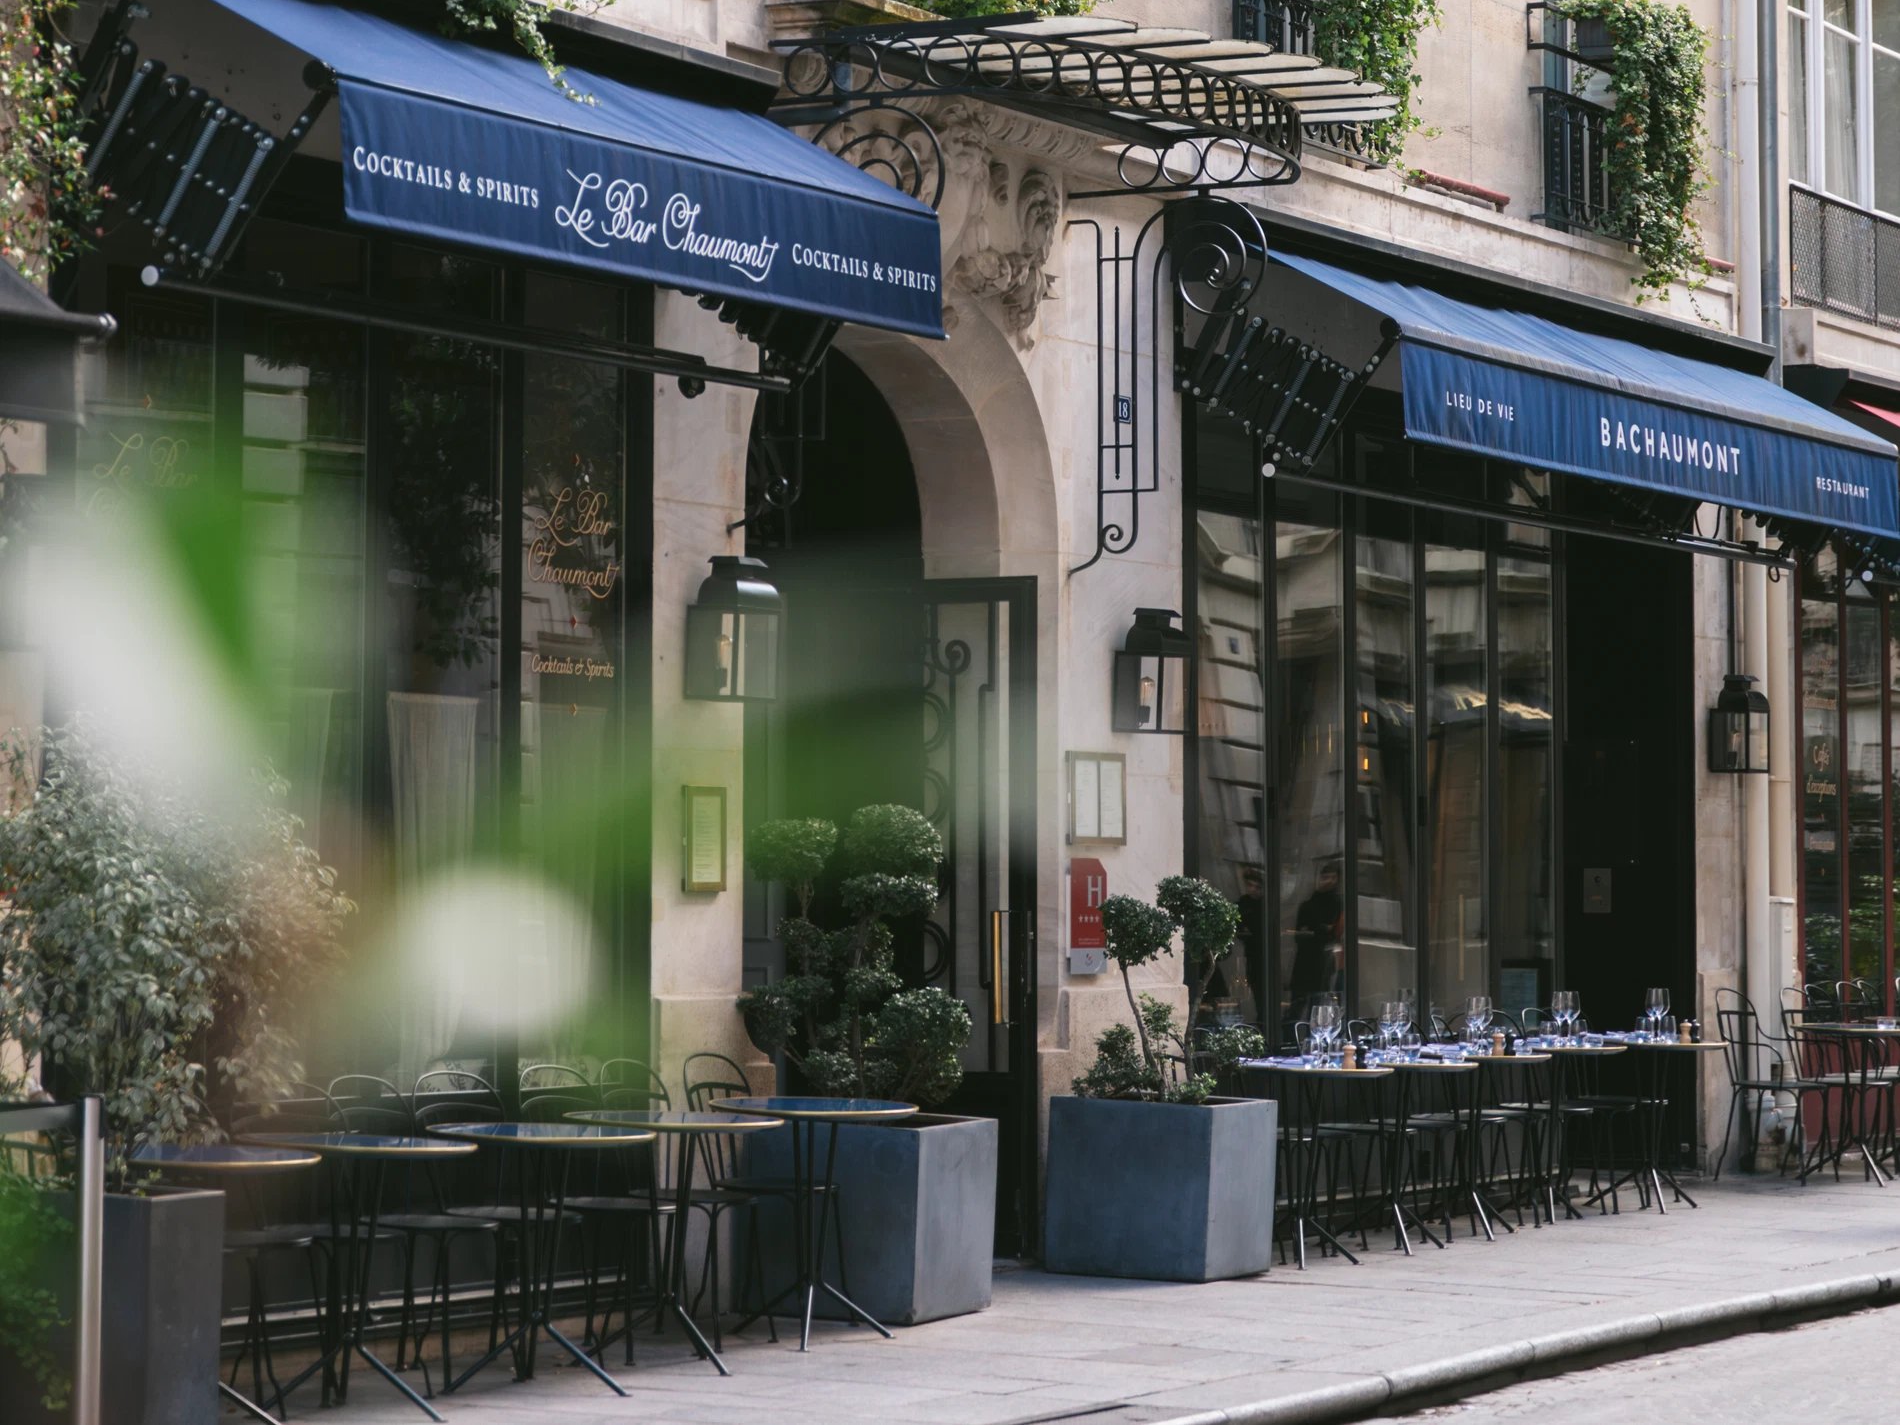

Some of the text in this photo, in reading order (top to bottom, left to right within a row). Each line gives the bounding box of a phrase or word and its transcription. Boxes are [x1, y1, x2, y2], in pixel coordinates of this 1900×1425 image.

[353, 146, 540, 209] COCKTAILS & SPIRITS
[555, 168, 779, 283] Le Bar Chaumont
[792, 243, 936, 293] COCKTAILS & SPIRITS
[1118, 401, 1129, 418] 18
[1446, 391, 1515, 422] LIEU DE VIE
[1600, 417, 1741, 477] BACHAUMONT
[1816, 476, 1870, 499] RESTAURANT
[534, 487, 612, 547] Le Bar
[527, 537, 620, 599] Chaumont
[1087, 875, 1102, 908] H
